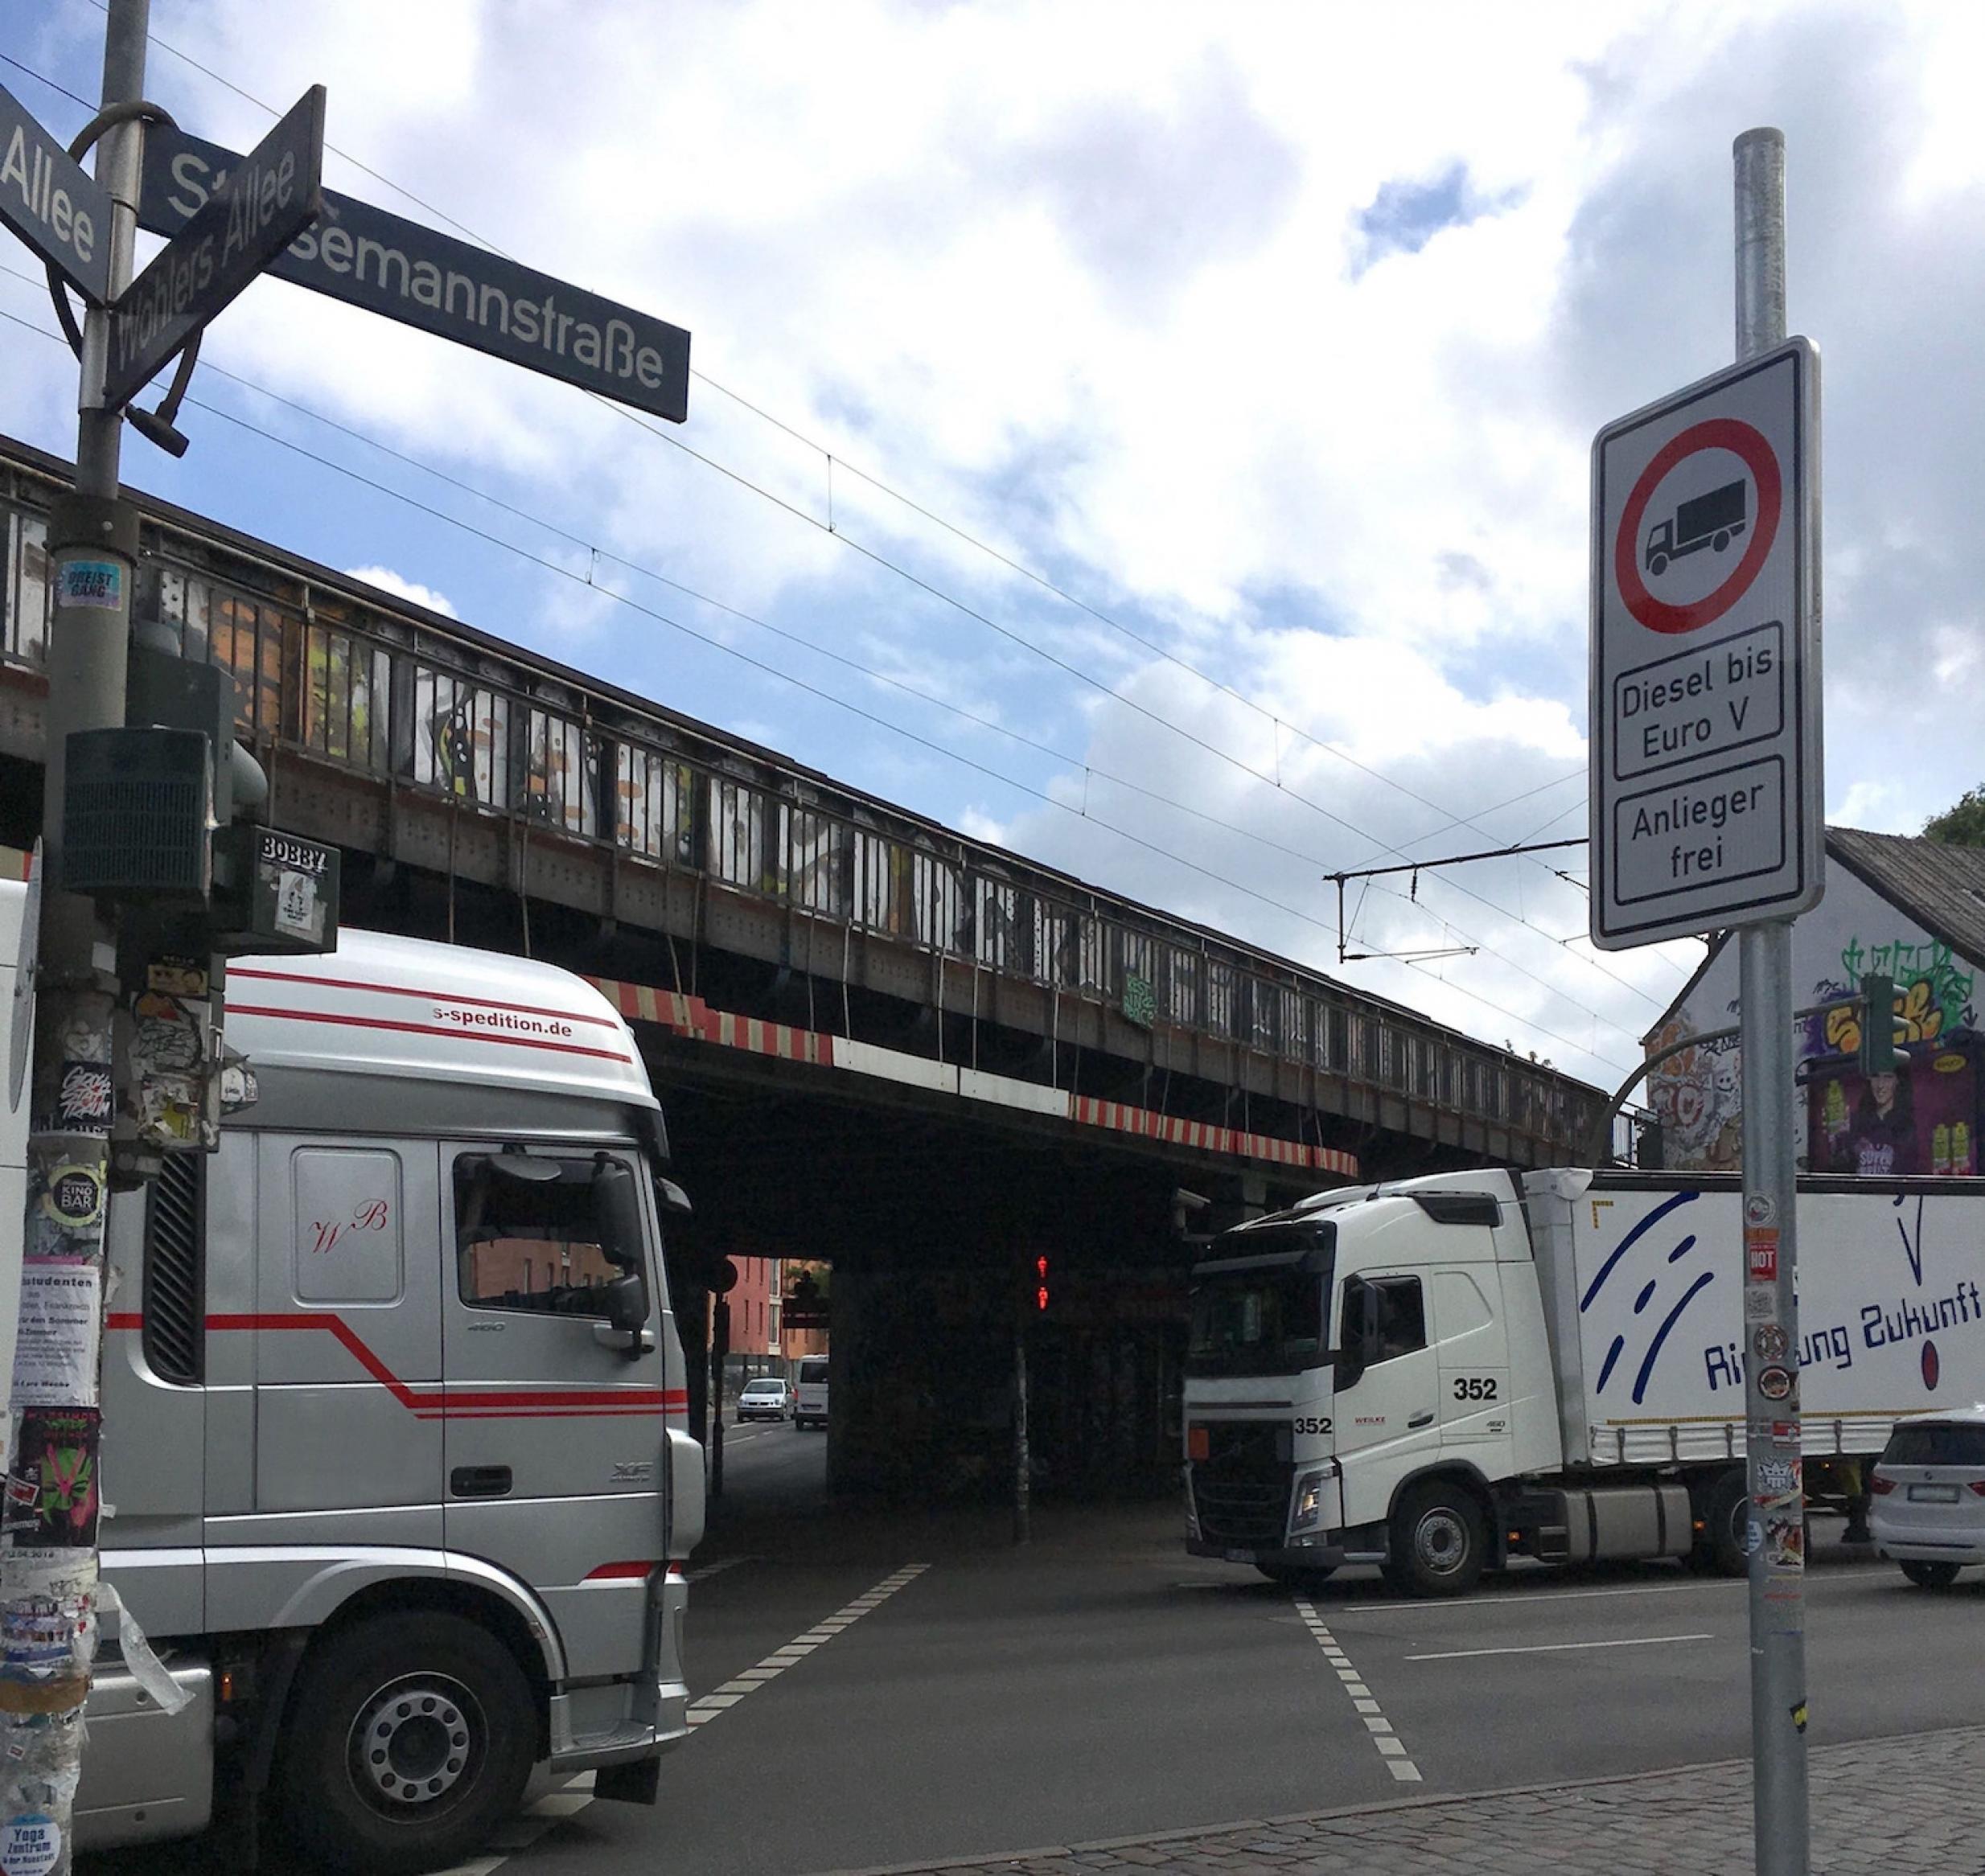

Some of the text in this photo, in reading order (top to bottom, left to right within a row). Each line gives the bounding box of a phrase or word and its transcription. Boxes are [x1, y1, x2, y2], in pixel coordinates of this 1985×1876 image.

[1, 125, 94, 263] Allee
[222, 150, 294, 268] Allee
[1623, 646, 1773, 718] Diesel bis
[1643, 696, 1749, 758] Euro V
[1631, 783, 1764, 841] Anlieger
[261, 836, 327, 873] BOBBY
[1671, 835, 1723, 878] frei
[62, 1185, 93, 1196] KINO
[62, 1194, 92, 1209] BAR
[308, 1197, 387, 1254] W B
[1751, 1250, 1774, 1268] HOT
[1860, 1282, 1982, 1349] Zukunft
[1453, 1377, 1498, 1400] 352
[1295, 1418, 1333, 1435] 352
[14, 1828, 44, 1841] Yoga
